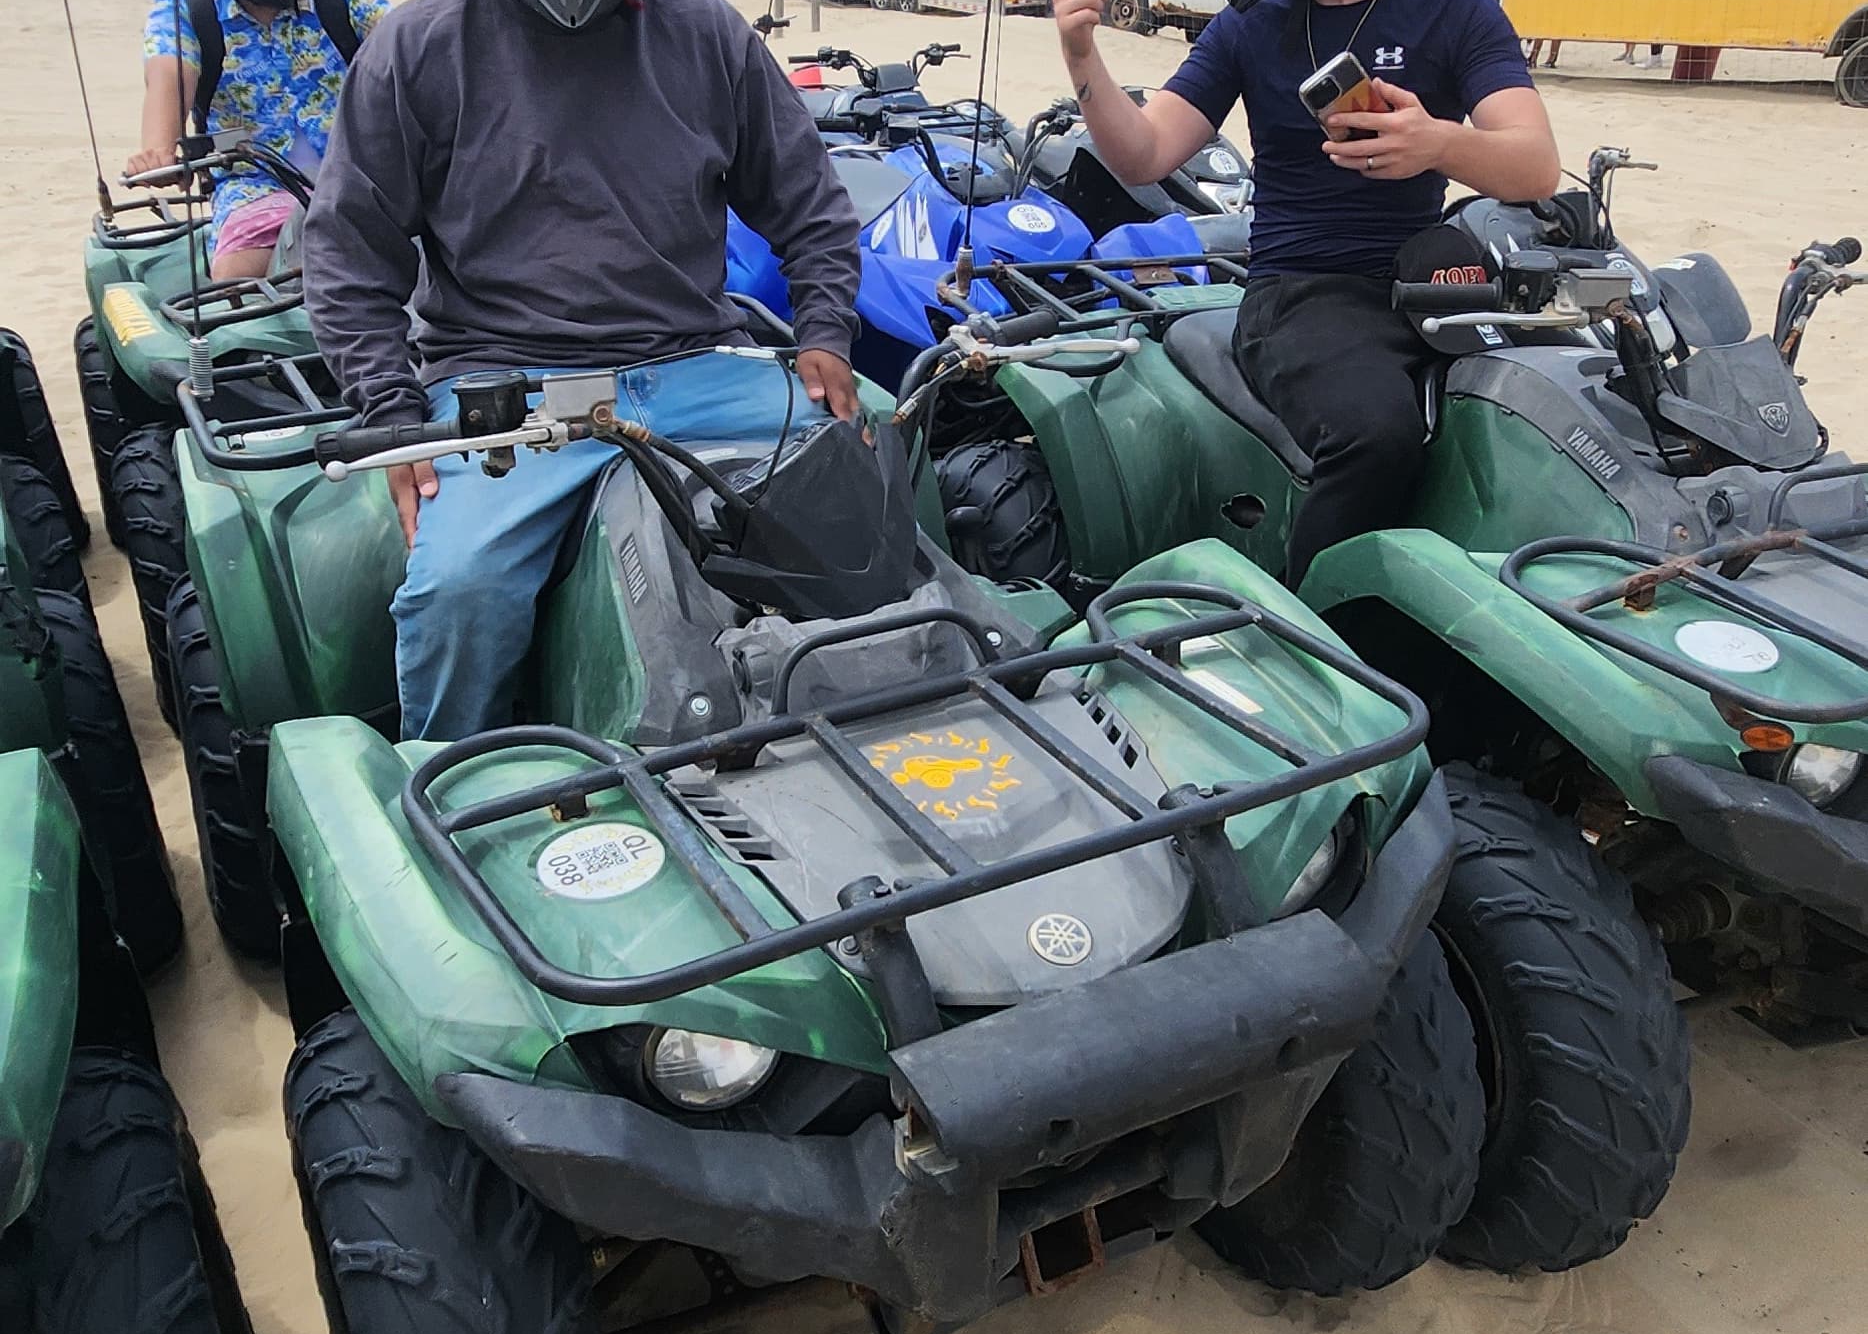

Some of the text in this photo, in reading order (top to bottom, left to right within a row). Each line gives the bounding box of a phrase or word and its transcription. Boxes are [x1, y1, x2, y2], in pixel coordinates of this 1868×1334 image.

[1567, 426, 1621, 480] YAMAHA
[620, 536, 648, 604] YAMAHA
[622, 834, 653, 860] QL
[547, 854, 584, 886] 038
